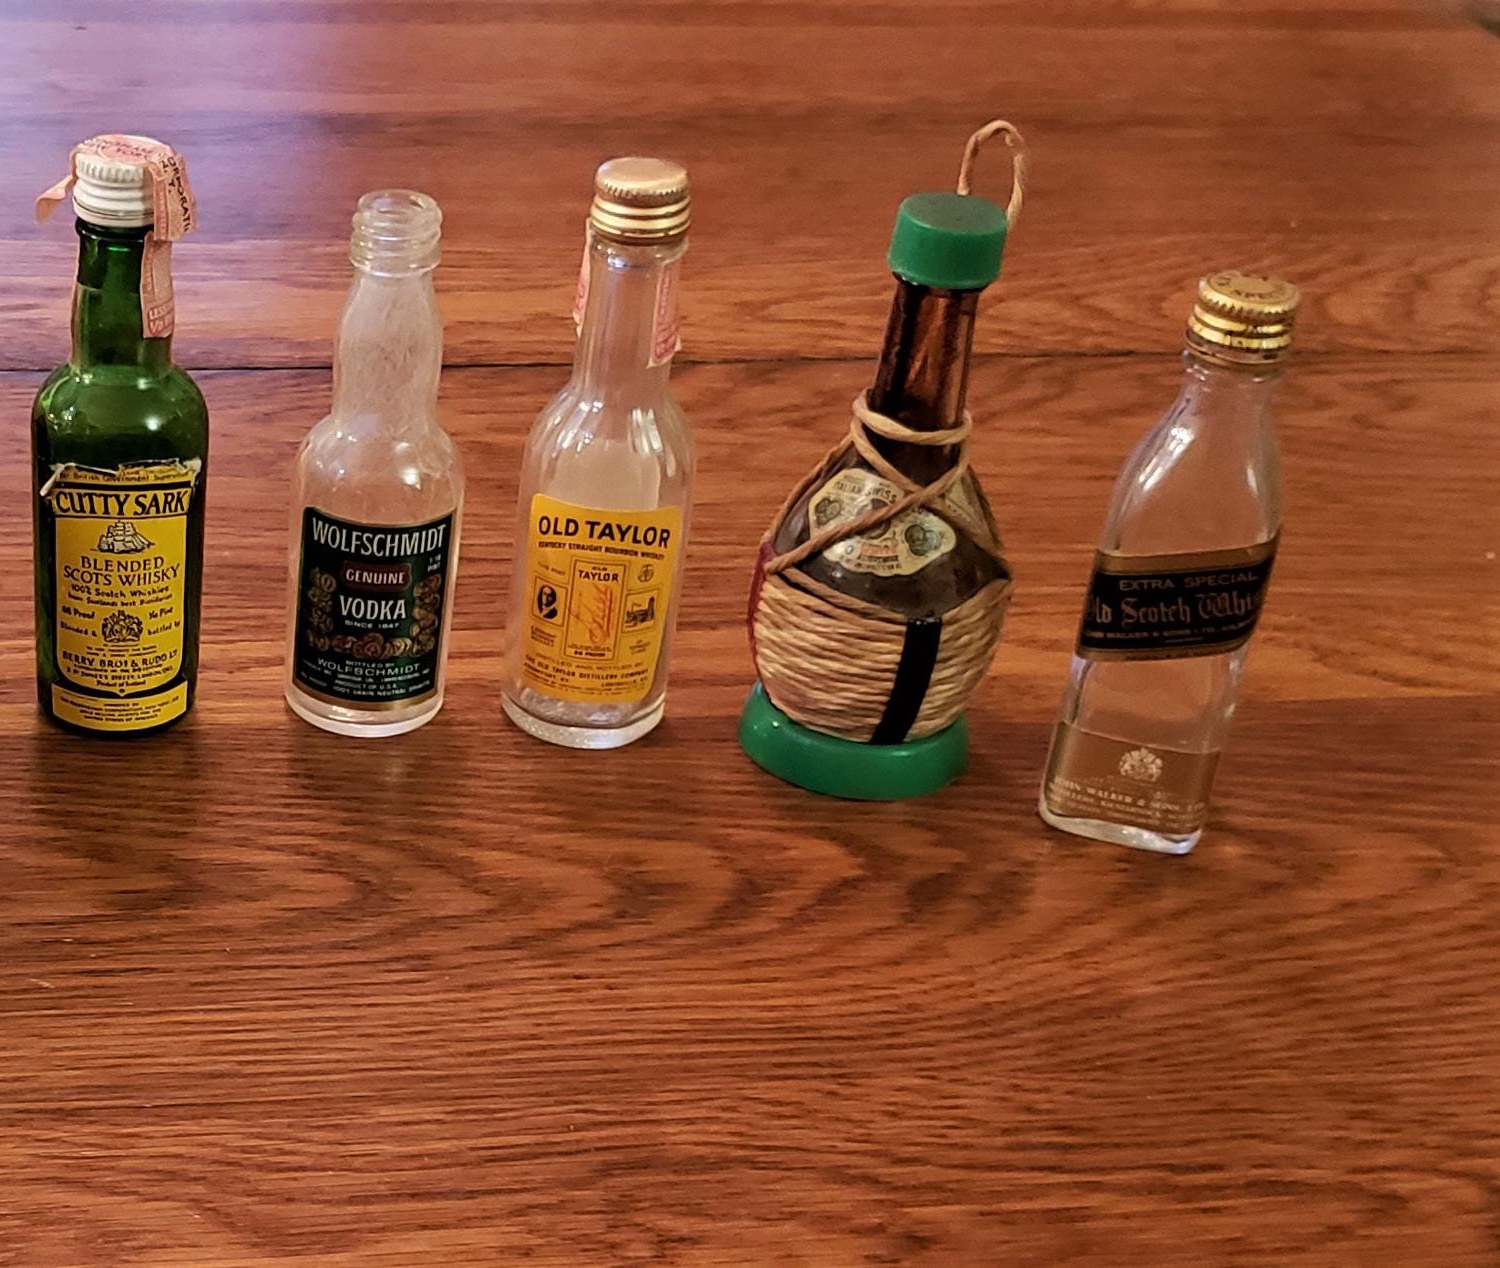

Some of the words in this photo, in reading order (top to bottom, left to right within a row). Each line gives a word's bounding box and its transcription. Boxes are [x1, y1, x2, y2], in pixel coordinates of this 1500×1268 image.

[56, 490, 130, 516] CUTTY
[133, 489, 188, 516] SARK
[312, 517, 447, 557] WOLFSCHMIDT
[538, 515, 580, 537] OLD
[585, 520, 671, 549] TAYLOR
[538, 541, 567, 549] KENTUCKY
[568, 542, 603, 552] STRAIGHT
[604, 546, 639, 557] BOURBON
[81, 556, 165, 572] BLENDED
[63, 565, 112, 586] SCOTS
[118, 565, 180, 587] WHISKY
[345, 568, 406, 585] GENUINE
[578, 570, 619, 582] TAYLOR
[1119, 578, 1175, 591] EXTRA
[1183, 571, 1259, 588] SPECIAL
[94, 587, 126, 598] Scotch
[73, 607, 95, 619] Proof
[339, 595, 407, 620] VODKA
[1120, 597, 1191, 629] Scotch
[344, 619, 373, 629] SINCE
[62, 650, 95, 667] BERRY
[130, 658, 139, 668] &
[317, 657, 421, 676] WOLFSCHMIDT
[551, 666, 576, 677] TAYLOR
[578, 672, 618, 680] DISTILLERY
